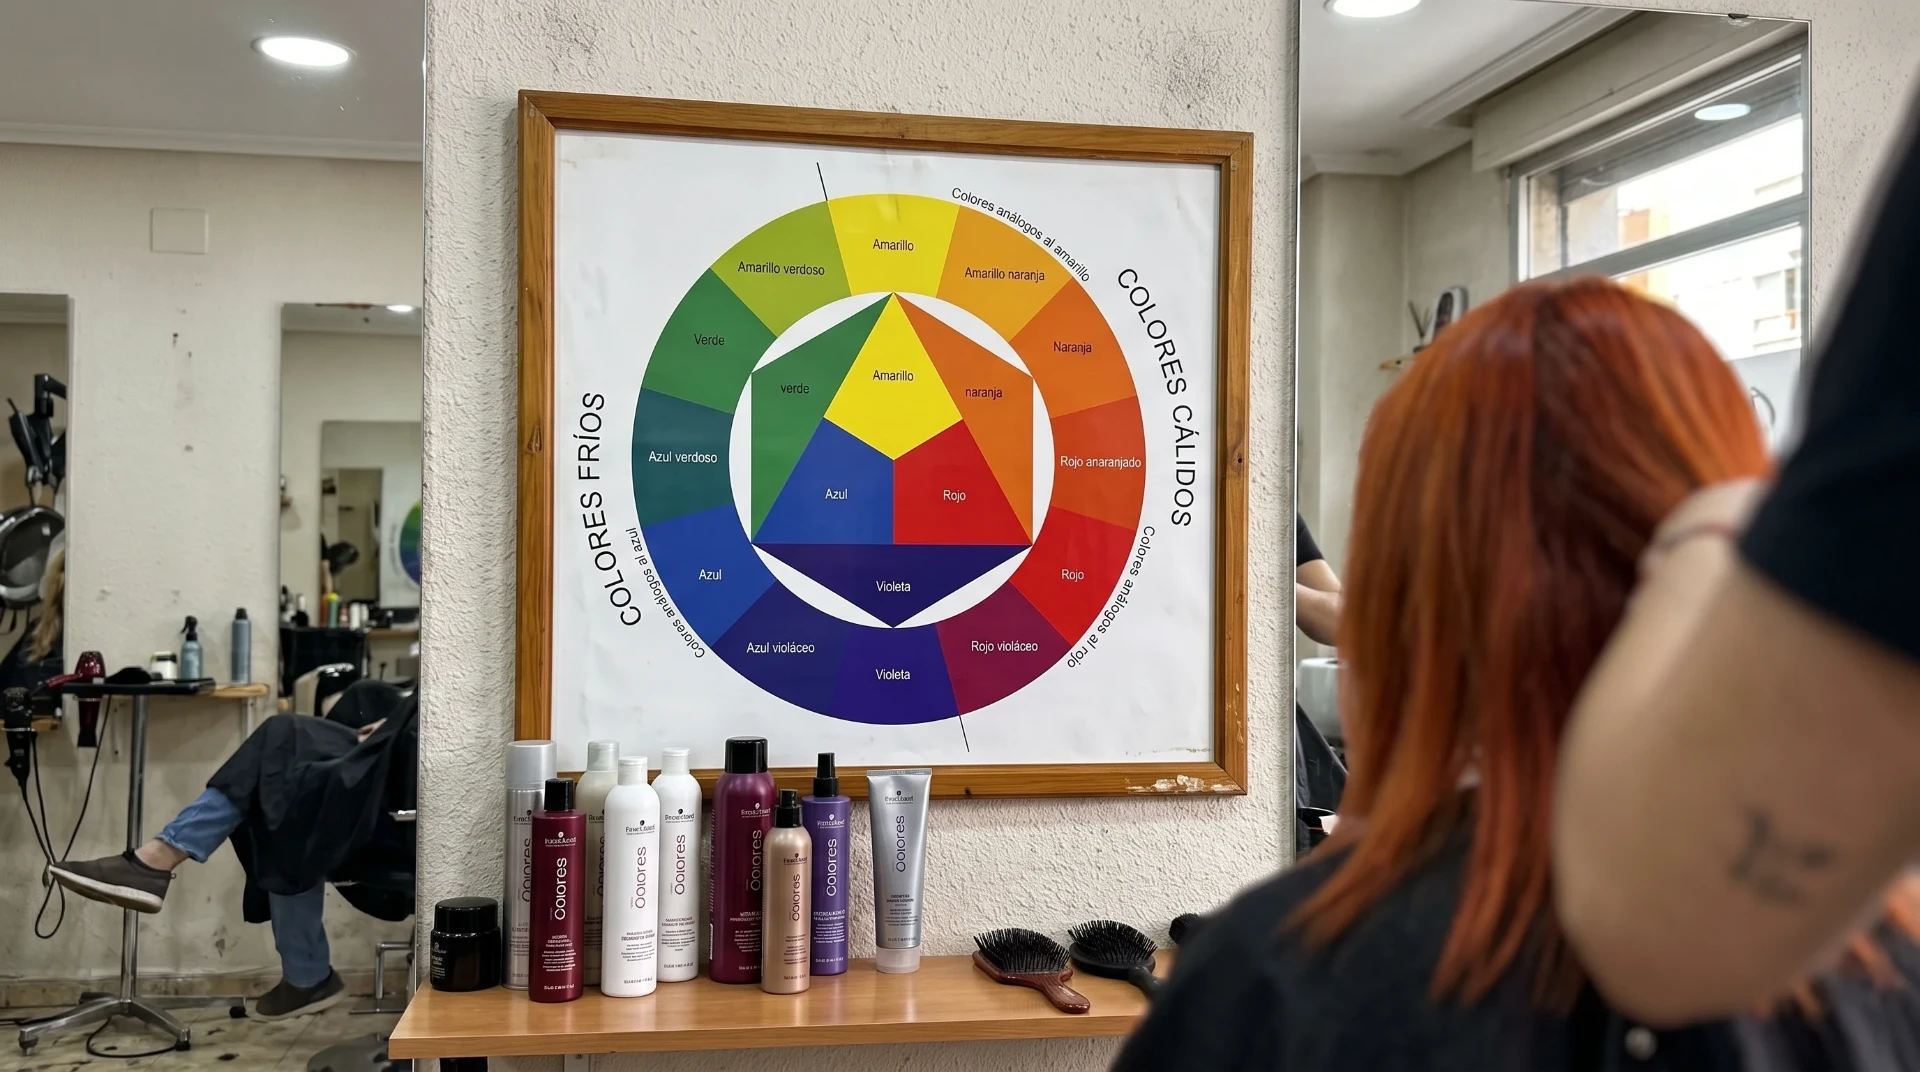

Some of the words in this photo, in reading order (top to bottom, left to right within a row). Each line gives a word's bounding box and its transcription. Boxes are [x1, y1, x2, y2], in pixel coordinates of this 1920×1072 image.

[952, 188, 995, 212] Colores
[996, 207, 1043, 240] análogos
[1043, 238, 1056, 248] al
[1053, 245, 1090, 282] amarillo
[872, 237, 915, 253] Amarillo
[737, 260, 781, 275] Amarillo
[783, 263, 826, 276] verdoso
[964, 265, 1006, 280] Amarillo
[1008, 269, 1046, 284] naranja
[694, 333, 725, 346] Verde
[1053, 340, 1093, 355] Naranja
[872, 368, 915, 383] Amarillo
[780, 382, 810, 394] verde
[964, 386, 1003, 400] naranja
[1118, 269, 1187, 395] COLORES
[1171, 405, 1200, 526] CÁLIDOS
[573, 393, 605, 480] FRÍOS
[648, 450, 672, 463] Azul
[675, 451, 718, 463] verdoso
[1060, 455, 1083, 471] Rojo
[1086, 456, 1142, 471] anaranjado
[824, 487, 849, 501] Azul
[942, 488, 967, 504] Rojo
[625, 527, 643, 552] azul
[580, 491, 642, 626] COLORES
[1130, 526, 1155, 577] Colores
[634, 555, 648, 565] al
[698, 568, 723, 581] Azul
[1060, 568, 1085, 583] Rojo
[643, 568, 675, 618] análogos
[875, 579, 912, 592] Violeta
[1097, 579, 1134, 634] análogos
[672, 619, 706, 658] Colores
[1086, 634, 1098, 650] al
[746, 640, 770, 654] Azul
[772, 640, 816, 654] violáceo
[971, 640, 995, 655] Rojo
[996, 639, 1039, 653] violáceo
[1067, 646, 1089, 668] rojo
[875, 667, 912, 681] Violeta
